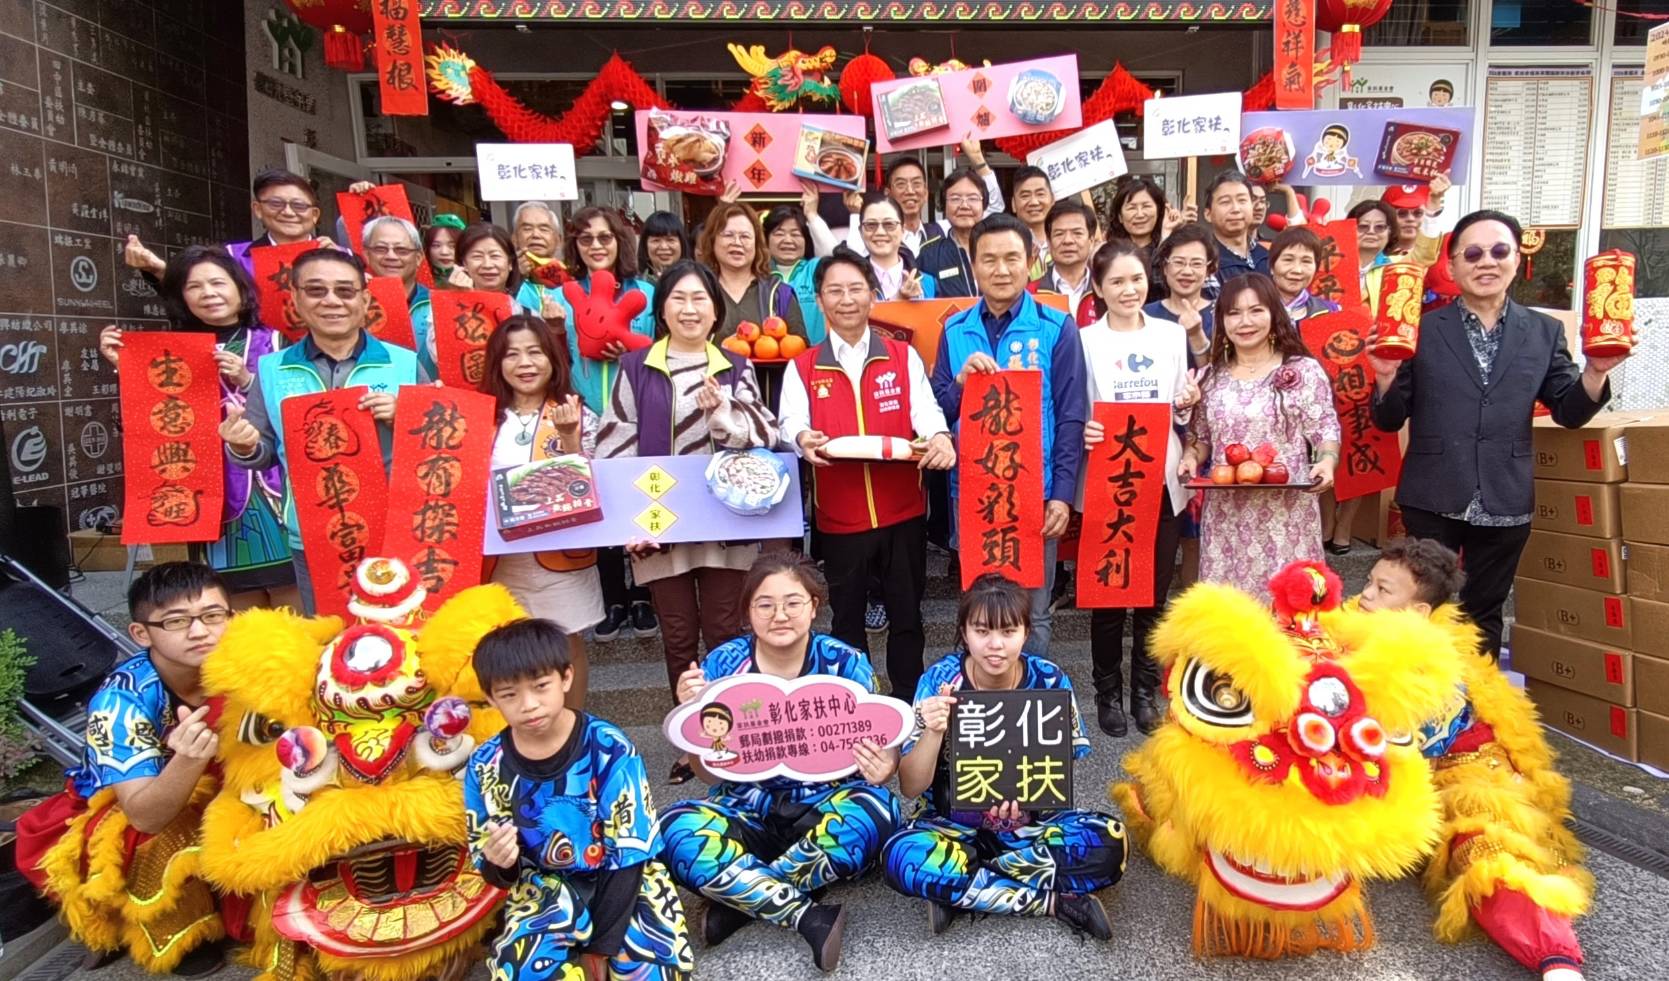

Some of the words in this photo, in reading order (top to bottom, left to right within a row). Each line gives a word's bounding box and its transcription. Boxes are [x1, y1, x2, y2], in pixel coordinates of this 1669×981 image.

[1162, 114, 1223, 138] 彰化家扶
[496, 162, 557, 182] 彰化家扶
[749, 130, 767, 184] 新年
[1046, 144, 1106, 181] 彰化家扶
[12, 471, 50, 485] E-LEAD
[969, 376, 1030, 573] 龍好彩頭
[1093, 414, 1156, 590] 大吉大利
[768, 692, 857, 726] 彰化家扶中心
[957, 699, 1064, 749] 彰化
[956, 755, 1067, 803] 家扶
